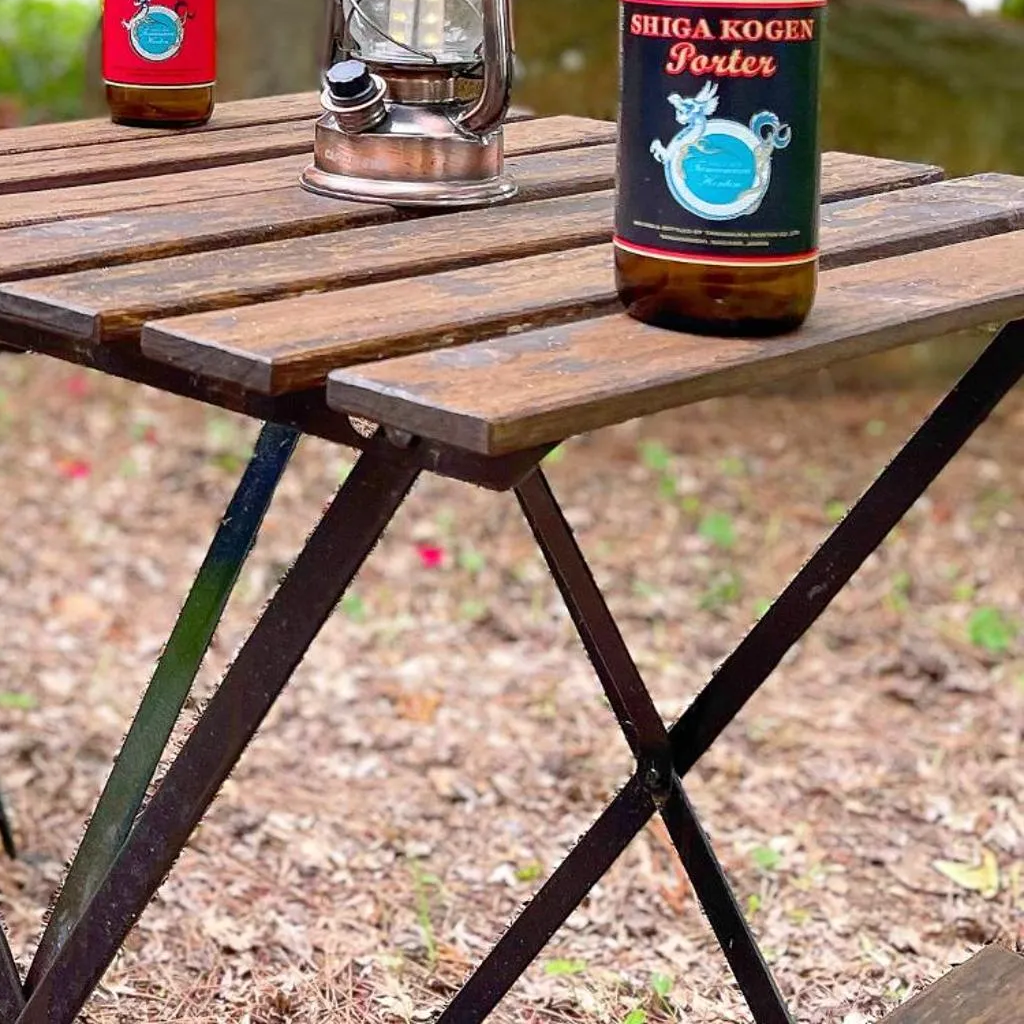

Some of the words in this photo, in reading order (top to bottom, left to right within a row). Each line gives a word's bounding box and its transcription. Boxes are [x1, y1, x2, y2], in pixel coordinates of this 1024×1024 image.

[630, 13, 714, 39] SHIGA
[720, 19, 815, 40] KOGEN
[666, 42, 776, 77] Porter
